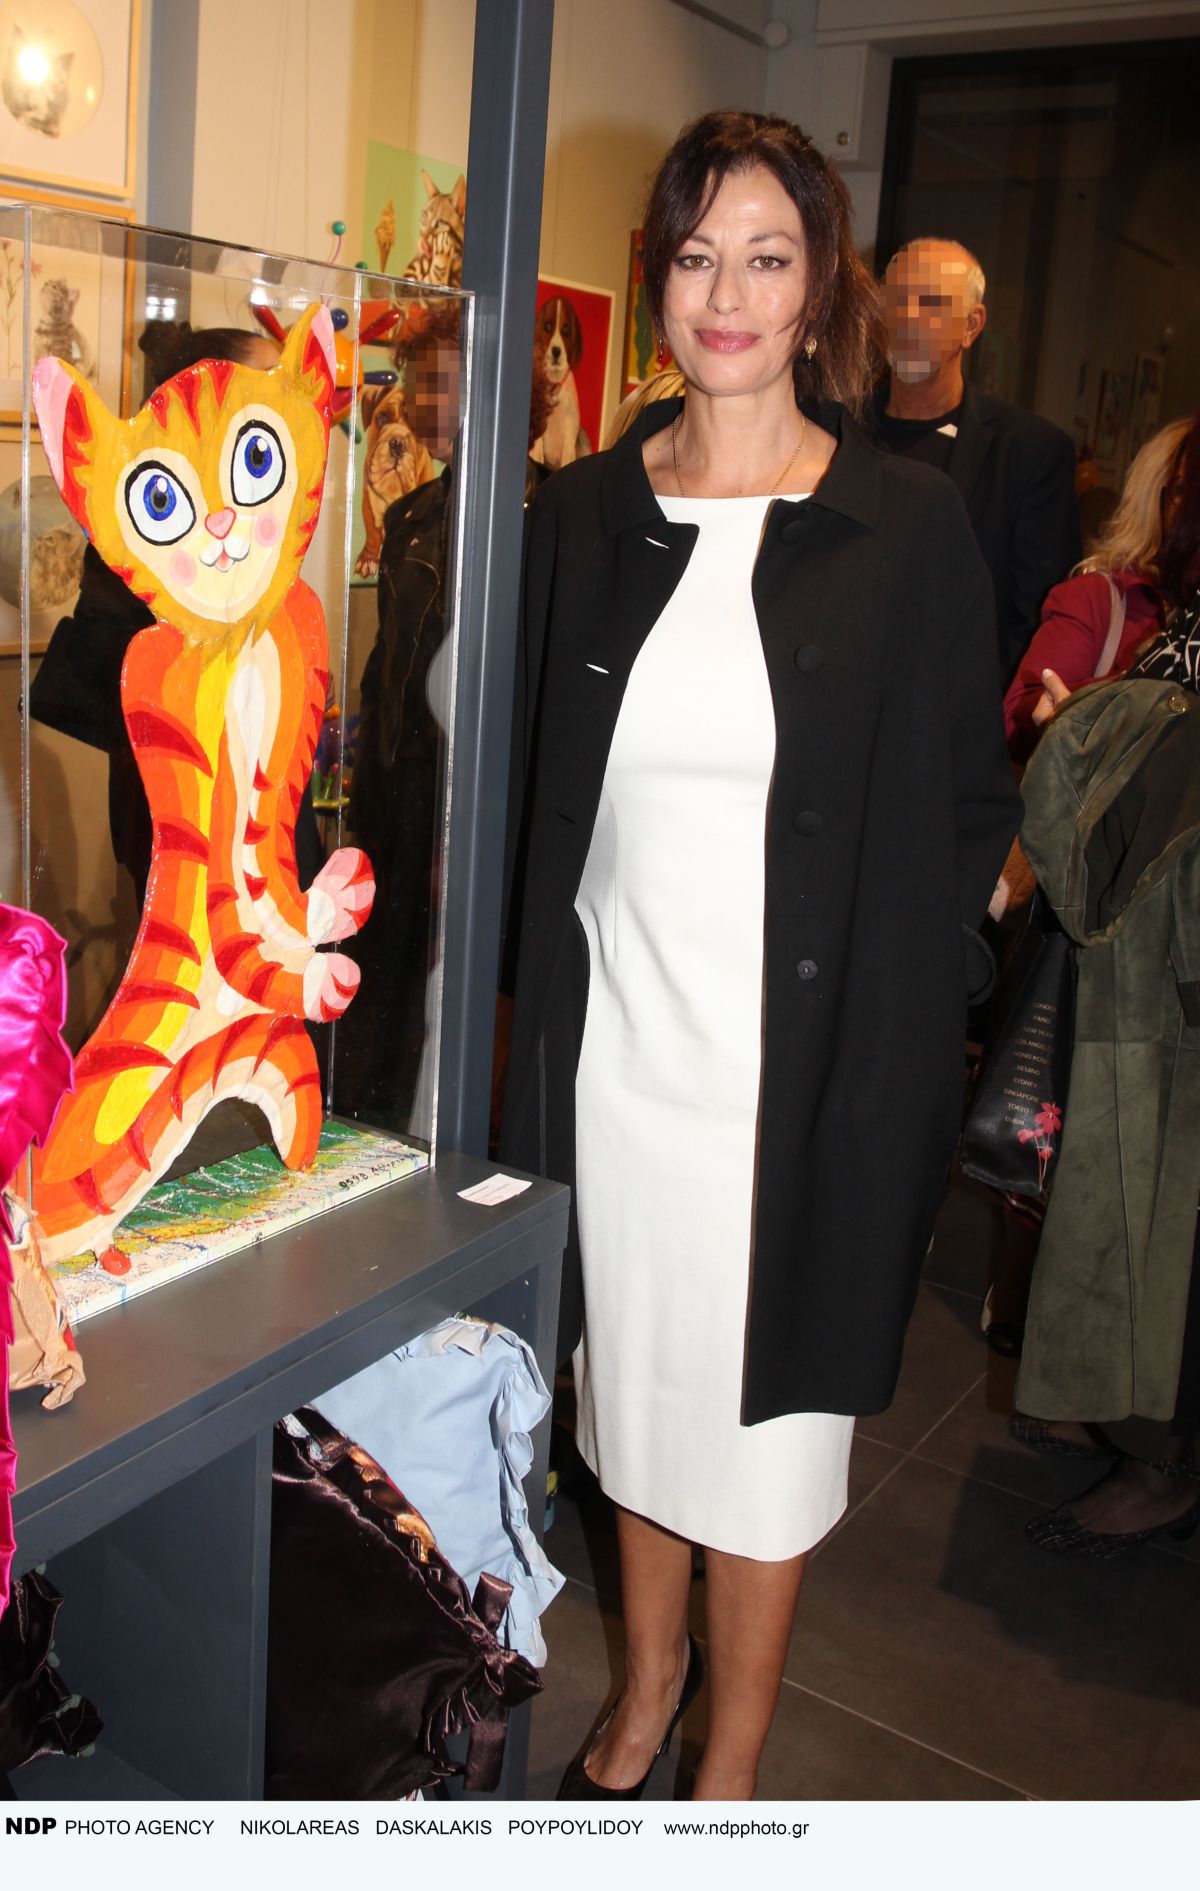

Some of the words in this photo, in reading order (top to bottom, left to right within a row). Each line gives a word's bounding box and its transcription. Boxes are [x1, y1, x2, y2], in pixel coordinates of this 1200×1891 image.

[1004, 1088, 1039, 1102] SINGAPORE
[1008, 1103, 1029, 1113] TOKYO
[1005, 1116, 1025, 1125] DUBAI
